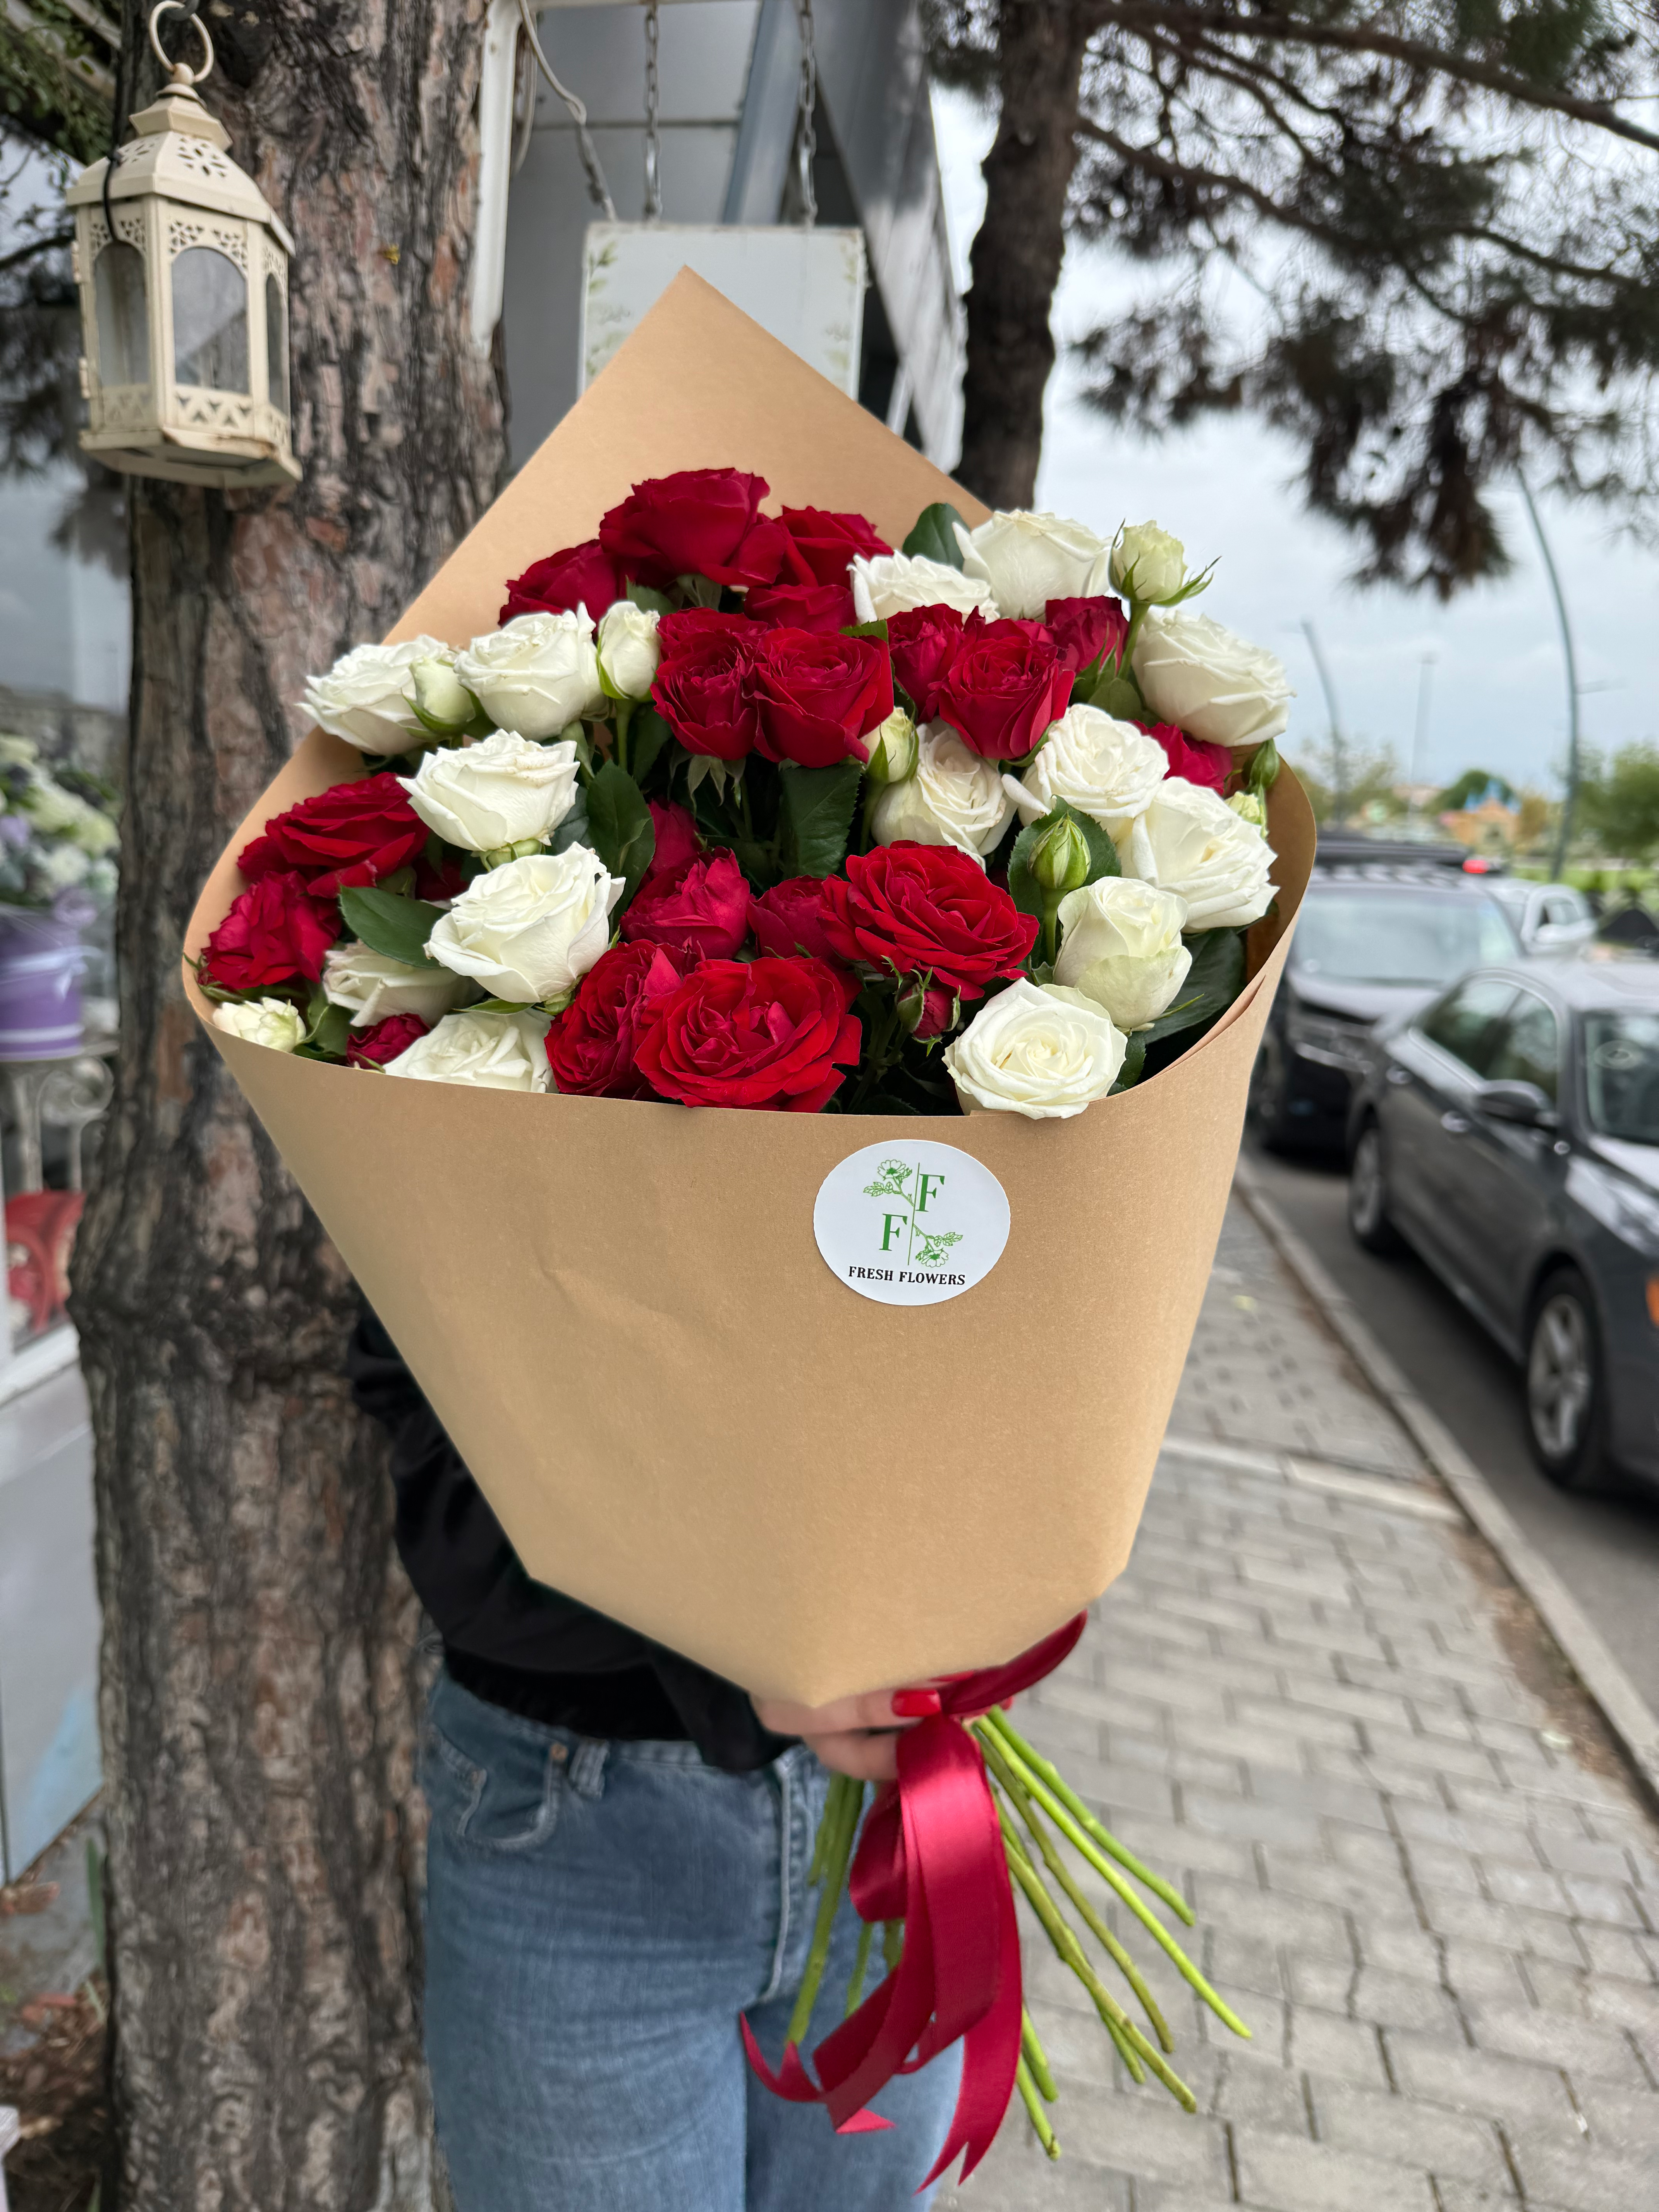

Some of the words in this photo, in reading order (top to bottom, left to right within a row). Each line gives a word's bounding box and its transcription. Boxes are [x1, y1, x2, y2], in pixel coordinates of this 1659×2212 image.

[915, 1173, 945, 1212] F
[879, 1213, 908, 1251] F
[848, 1266, 894, 1281] FRESH
[898, 1271, 966, 1285] FLOWERS
